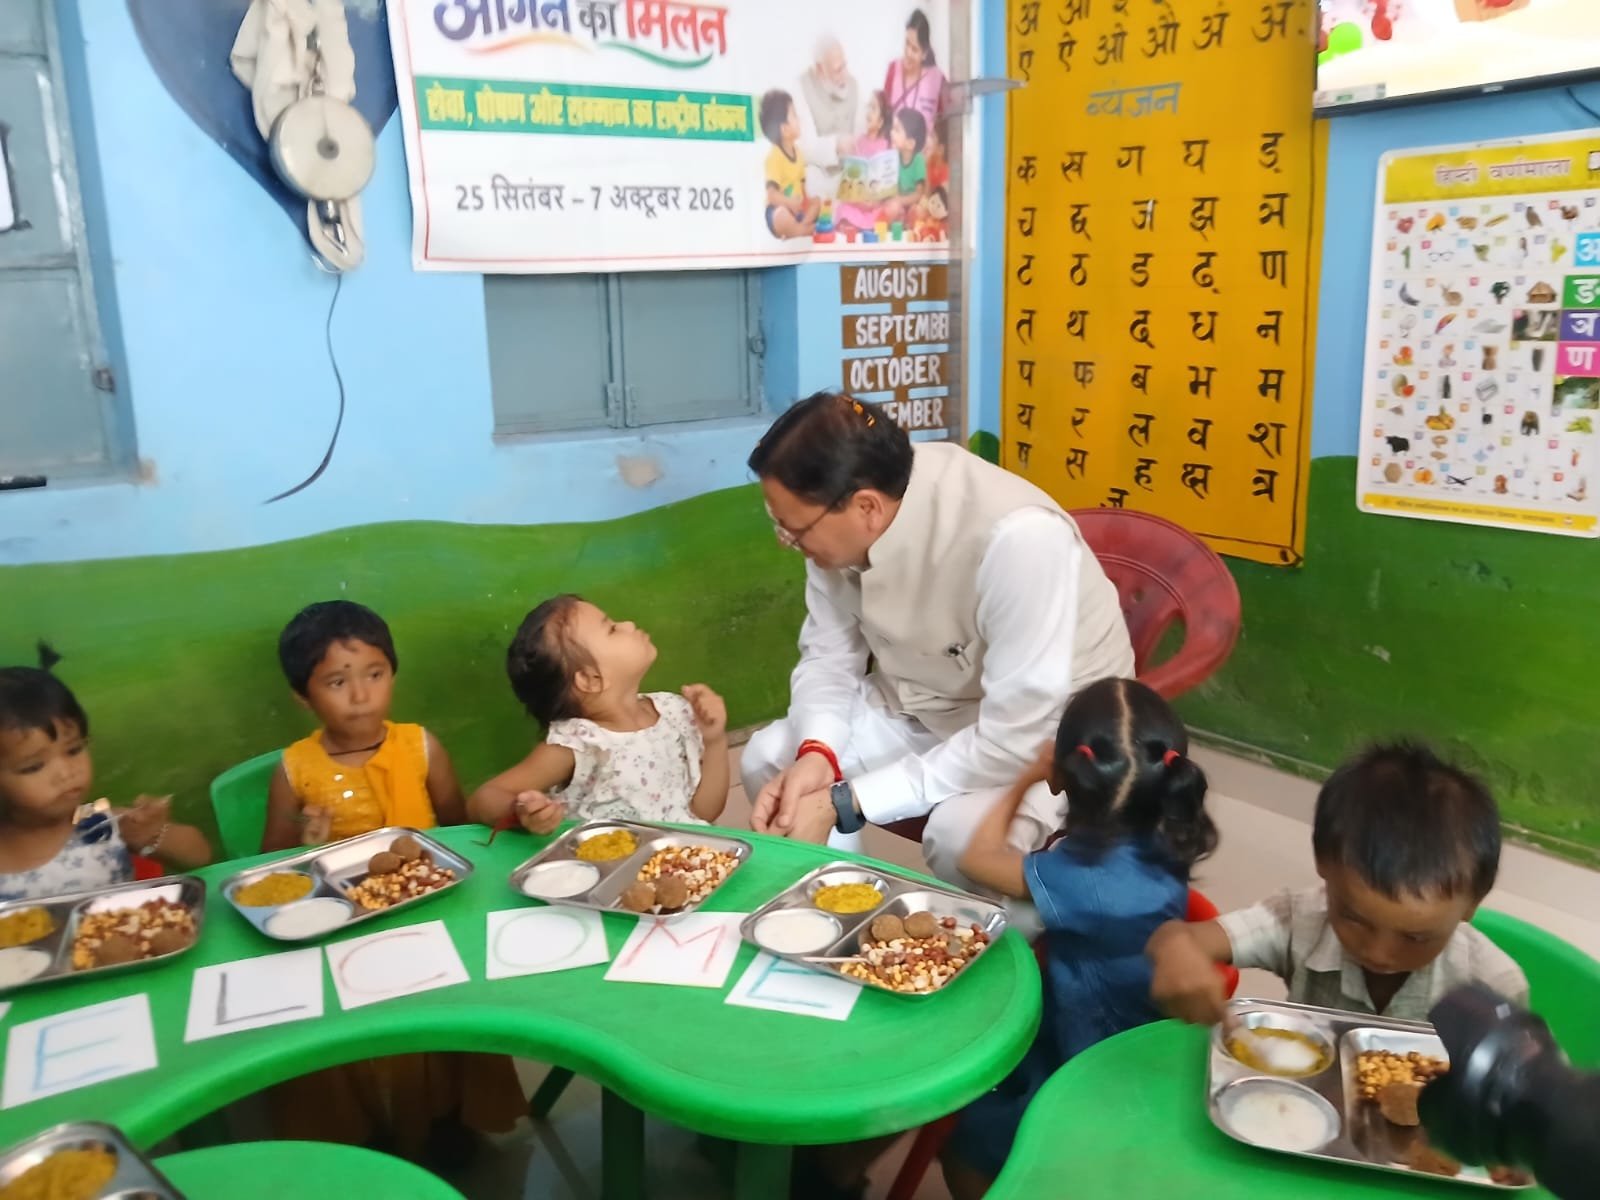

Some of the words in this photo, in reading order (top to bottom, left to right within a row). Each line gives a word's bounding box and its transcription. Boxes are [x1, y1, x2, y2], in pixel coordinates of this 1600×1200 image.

[579, 0, 618, 39] का
[625, 0, 729, 55] मिलन
[1017, 2, 1040, 36] अ
[1018, 157, 1036, 182] क
[1062, 152, 1086, 180] ख
[1117, 146, 1145, 173] ग
[1183, 140, 1209, 170] घ
[455, 185, 485, 211] 25
[491, 173, 565, 211] सितंबर
[590, 186, 602, 211] 7
[610, 184, 681, 218] अक्टूबर
[689, 186, 735, 211] 2026
[1018, 207, 1036, 237] च
[1071, 204, 1090, 240] छ
[1132, 200, 1157, 231] ज
[1190, 197, 1218, 241] झ
[854, 267, 930, 299] AUGUST
[1017, 255, 1034, 285] ट
[1070, 254, 1088, 286] ठ
[1132, 253, 1153, 287] ड
[1260, 251, 1287, 286] ण
[1016, 310, 1036, 342] त
[1067, 311, 1088, 339] थ
[1130, 310, 1154, 348] द
[1190, 312, 1218, 341] ध
[1257, 311, 1282, 344] न
[850, 354, 941, 390] OCTOBER
[1565, 346, 1597, 371] ण
[1019, 361, 1035, 386] प
[1131, 365, 1151, 393] ब
[1189, 366, 1216, 397] भ
[1259, 370, 1284, 401] म
[1018, 404, 1034, 428] य
[1072, 408, 1090, 437] र
[1128, 414, 1155, 447] ल
[1188, 419, 1212, 450] व
[1248, 423, 1286, 458] श
[1066, 448, 1088, 479] स
[1134, 458, 1157, 491] ह
[1182, 464, 1212, 499] क्ष
[33, 1009, 125, 1091] E
[215, 971, 307, 1026] L
[339, 931, 447, 994] C
[494, 915, 590, 969] O
[622, 919, 728, 973] M
